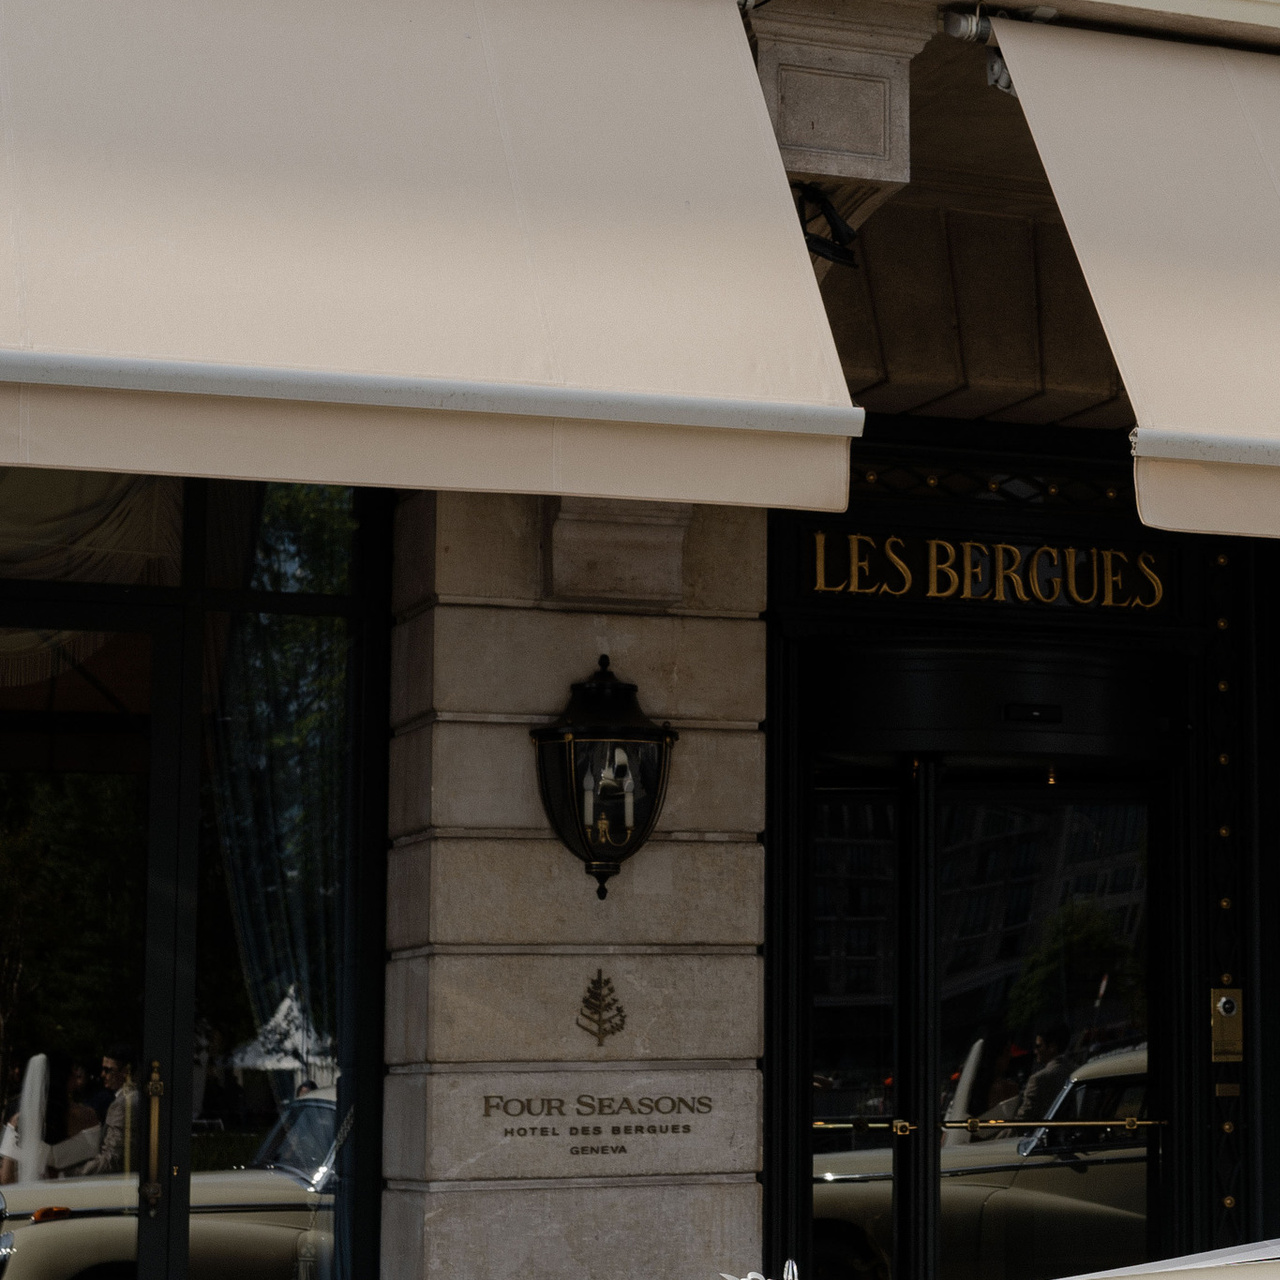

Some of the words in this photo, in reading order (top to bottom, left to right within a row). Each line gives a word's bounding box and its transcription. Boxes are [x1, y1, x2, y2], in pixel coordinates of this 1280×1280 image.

[813, 531, 913, 597] LES
[926, 539, 1165, 608] BERGUES
[482, 1094, 567, 1118] FOUR
[575, 1093, 714, 1116] SEASONS
[503, 1125, 560, 1138] HOTEL
[569, 1125, 603, 1137] DES
[611, 1123, 692, 1136] BERGUES
[570, 1144, 628, 1156] GENEVA
